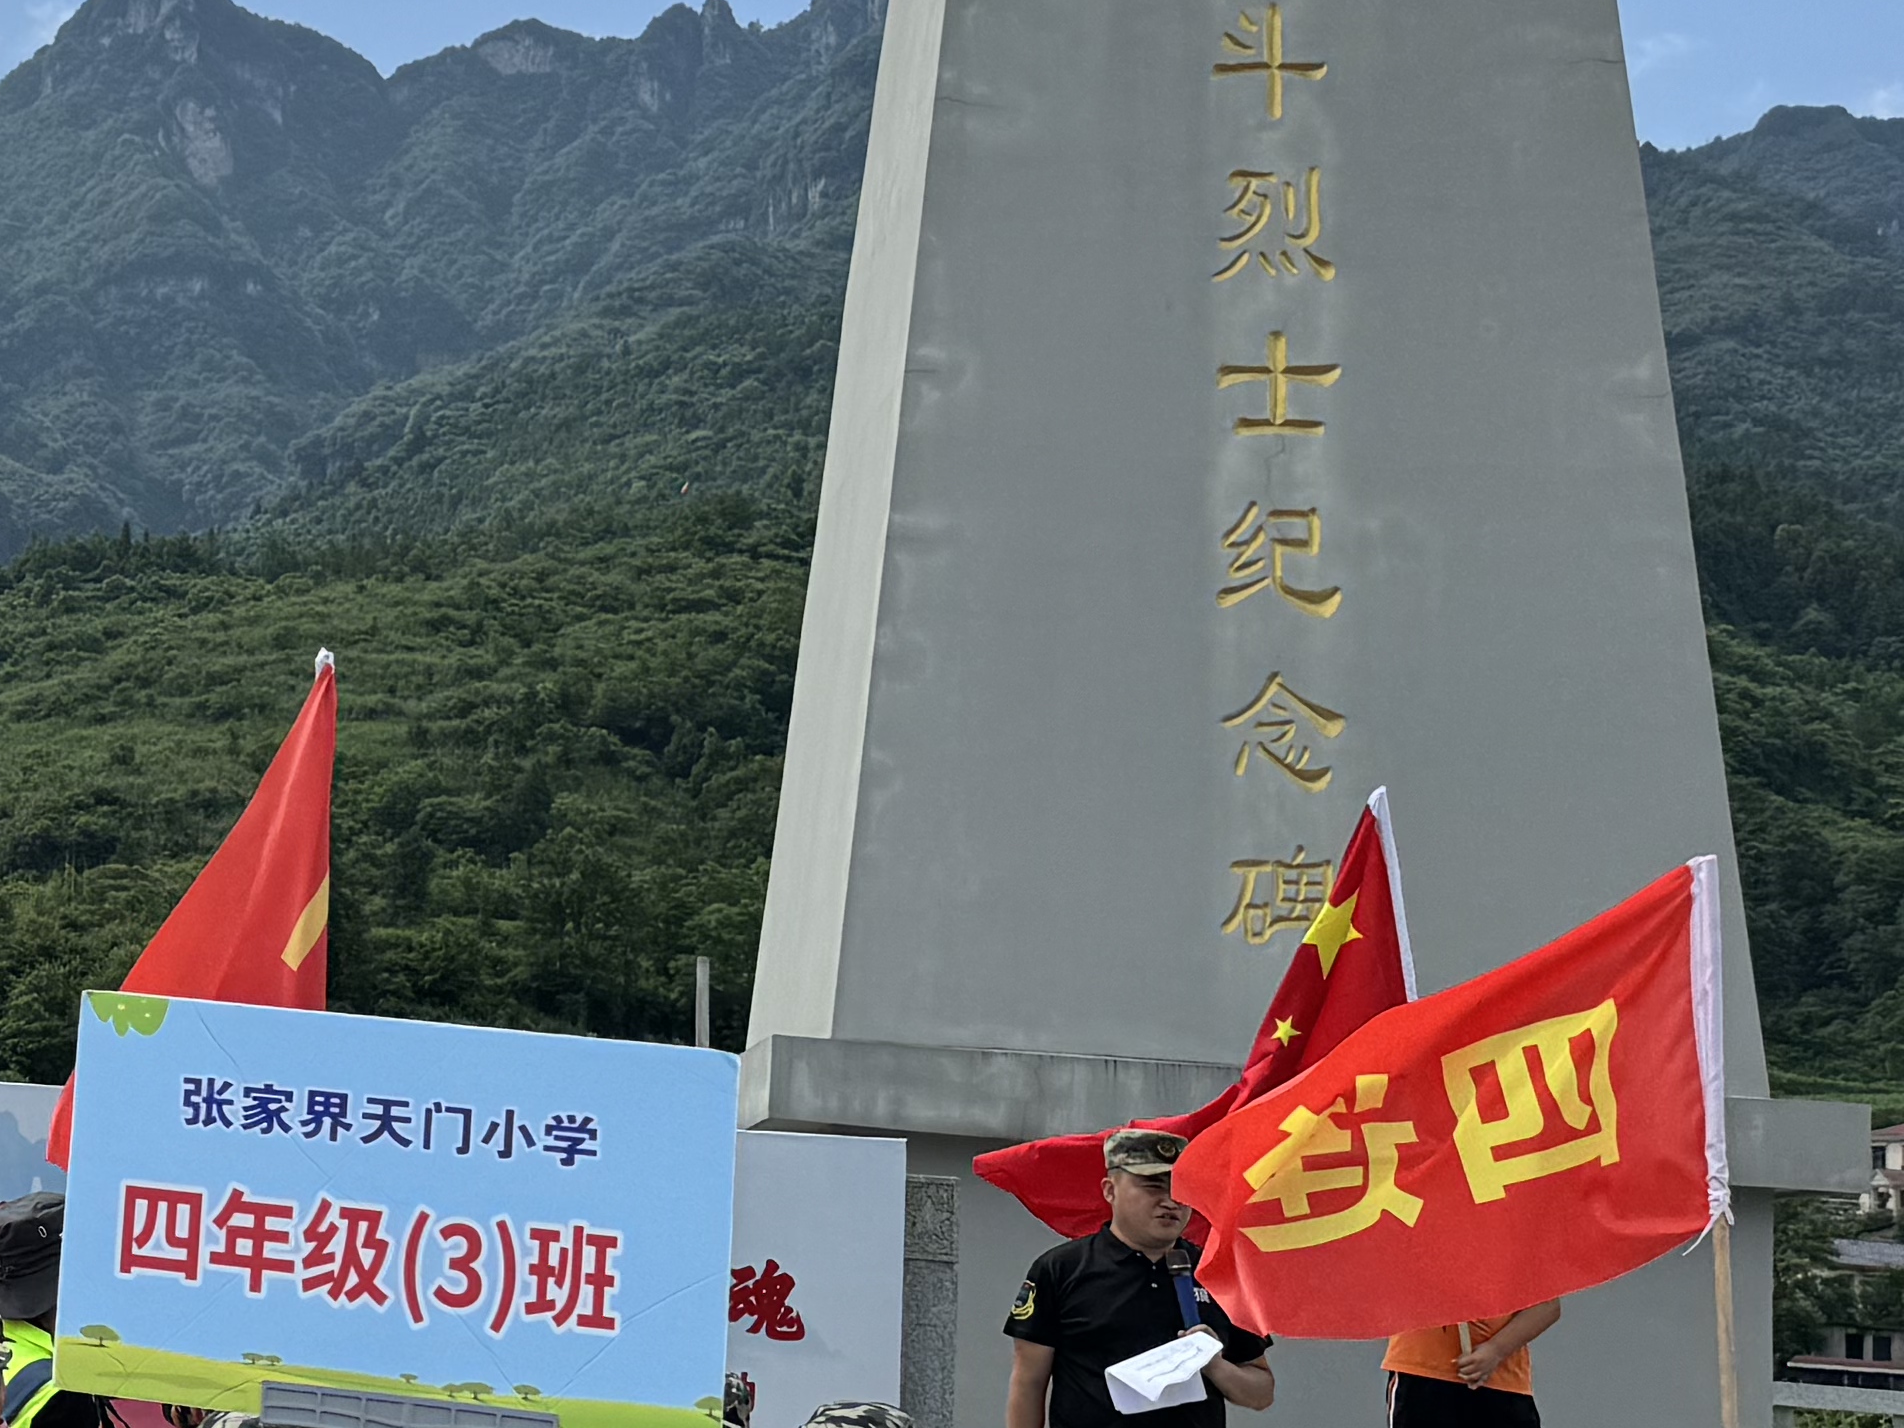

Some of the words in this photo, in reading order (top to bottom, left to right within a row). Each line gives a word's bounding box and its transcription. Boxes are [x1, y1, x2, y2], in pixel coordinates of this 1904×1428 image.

[182, 1077, 599, 1167] 张家界天门小学
[120, 1184, 619, 1333] 四年级(3)班
